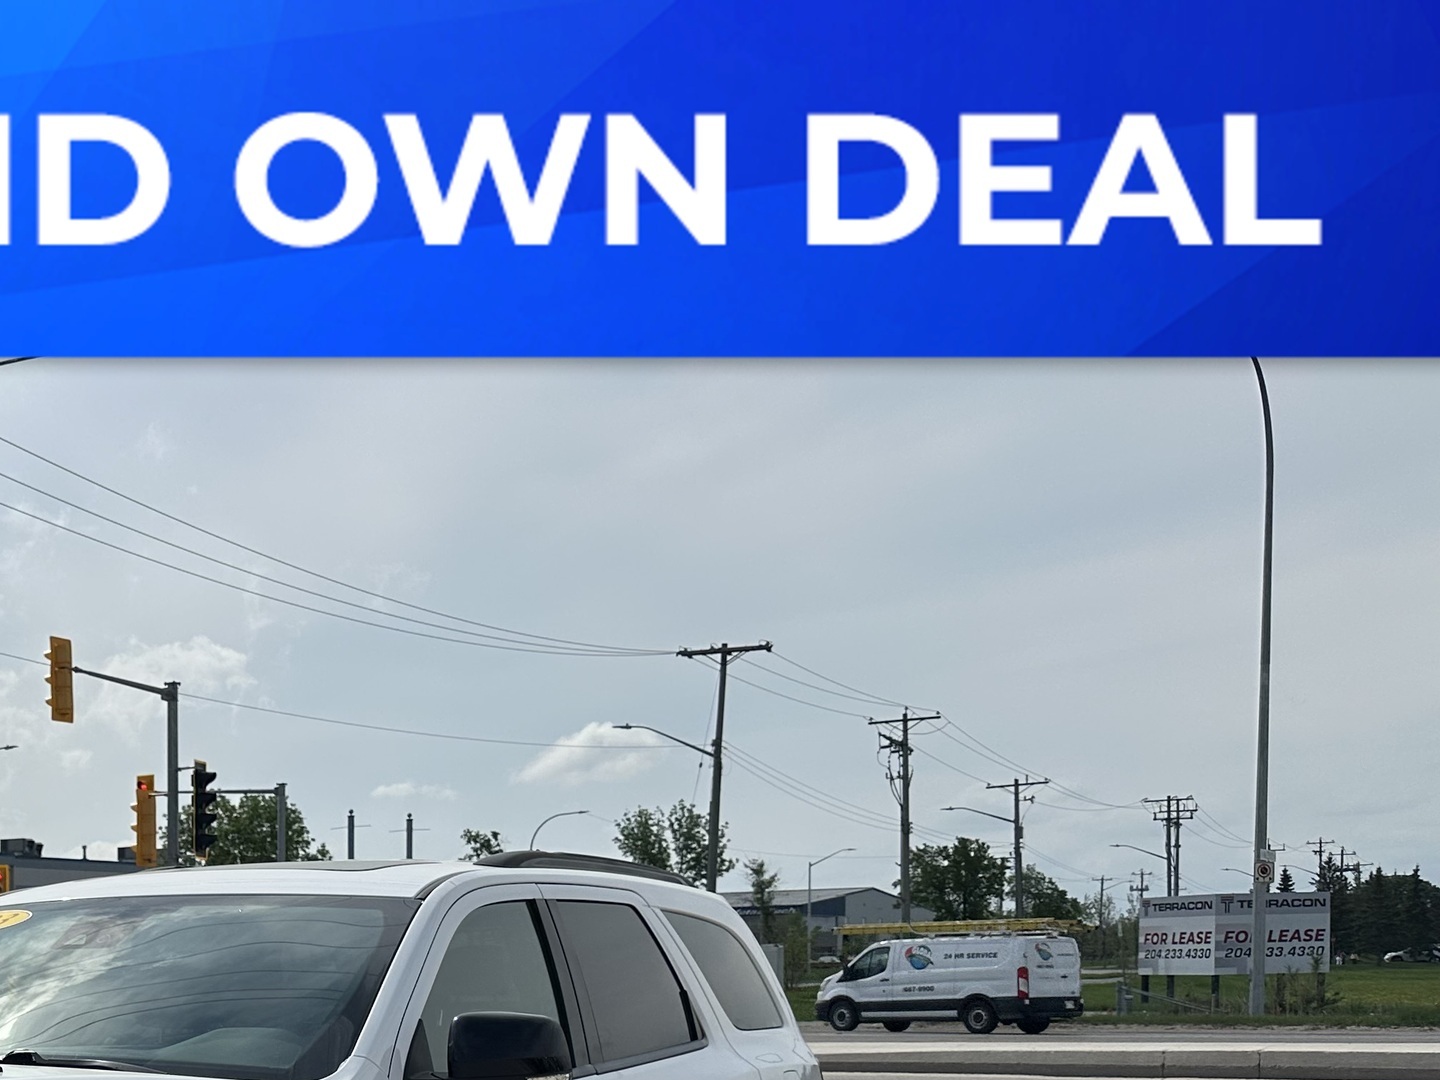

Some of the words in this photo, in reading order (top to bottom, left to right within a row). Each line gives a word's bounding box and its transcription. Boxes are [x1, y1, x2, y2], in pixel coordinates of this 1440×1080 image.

[1152, 900, 1213, 912] TERRACON
[1237, 898, 1326, 909] TERACON
[1144, 932, 1168, 945] FOR
[1172, 931, 1213, 945] LEASE
[1224, 930, 1252, 944] FO
[1267, 928, 1326, 943] LEASE
[1144, 948, 1211, 960] 204.233.4330
[1224, 946, 1325, 958] 20433.4330
